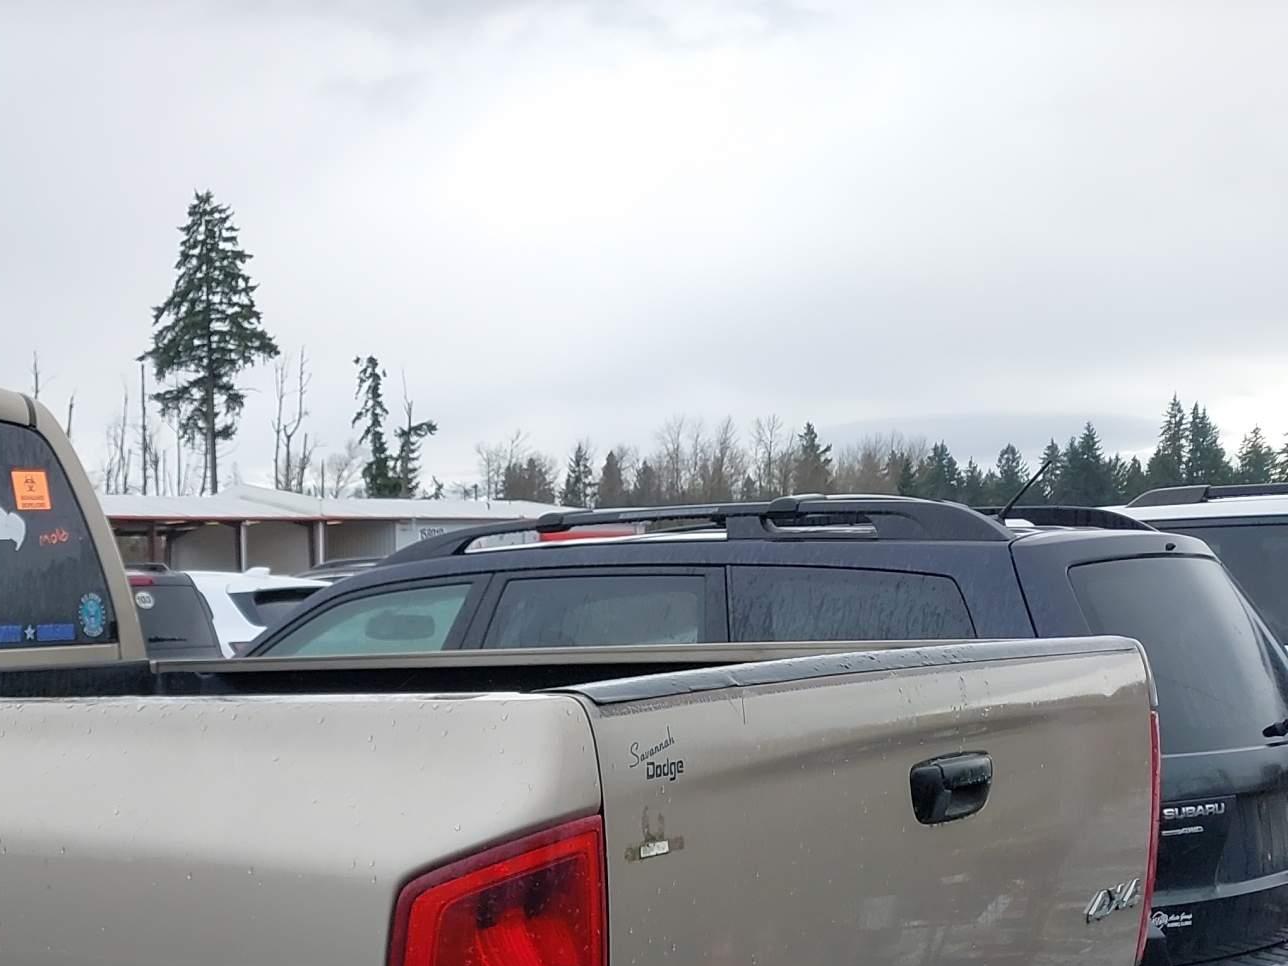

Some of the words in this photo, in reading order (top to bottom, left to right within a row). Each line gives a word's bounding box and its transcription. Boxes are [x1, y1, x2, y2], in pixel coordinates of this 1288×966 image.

[629, 725, 675, 768] Savannah
[646, 757, 684, 781] Dodge
[1162, 802, 1225, 820] SUBARU
